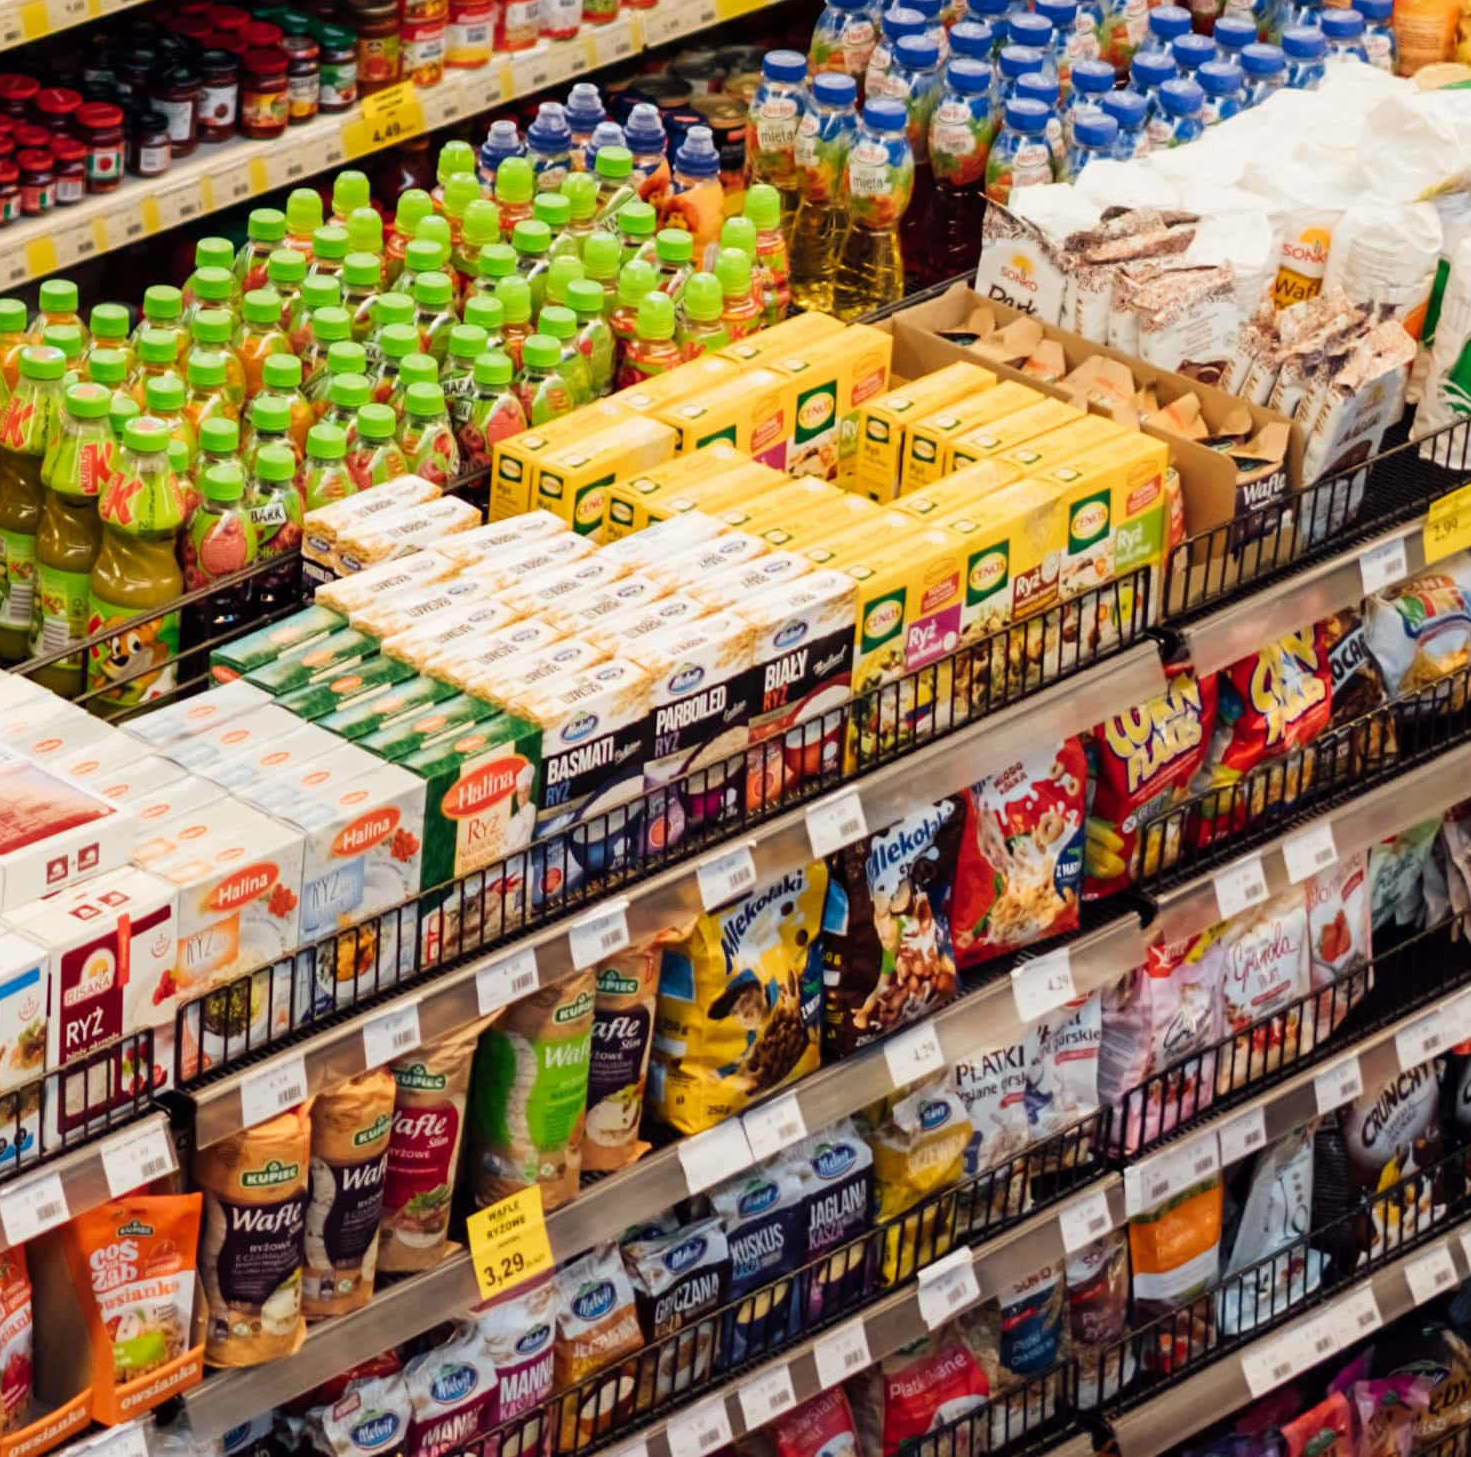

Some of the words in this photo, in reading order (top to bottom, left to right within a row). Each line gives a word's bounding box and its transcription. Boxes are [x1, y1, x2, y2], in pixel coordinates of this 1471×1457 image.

[1000, 265, 1039, 293] SONKO
[1273, 274, 1324, 303] Wafl
[841, 418, 859, 443] Ry
[1243, 473, 1286, 504] Wafle
[577, 495, 605, 517] CENO
[1016, 570, 1040, 597] Ryż
[909, 621, 935, 651] Ryż
[764, 648, 808, 692] BIAŁY
[656, 685, 726, 735] PARBOILED
[547, 737, 614, 784] BASMATI
[459, 771, 515, 810] Halina
[342, 816, 391, 850] Halina
[218, 873, 268, 905] Halina
[720, 870, 804, 975] Mlekołaki
[65, 976, 113, 1006] RISANA
[597, 979, 636, 993] UPIEC
[1047, 974, 1069, 993] 4.29
[65, 1005, 105, 1046] RYŻ
[592, 1018, 640, 1040] afle
[913, 1042, 936, 1062] 4.29
[956, 1045, 1024, 1084] PŁATKI
[390, 1112, 448, 1140] afle
[247, 1167, 297, 1186] KUPIEC
[232, 1202, 303, 1233] Wafle
[488, 1200, 520, 1222] WAFLE
[486, 1215, 527, 1241] RYŻOWE
[730, 1223, 785, 1265] KUSKUS
[484, 1251, 525, 1287] 3,29
[121, 1362, 198, 1412] owsianka
